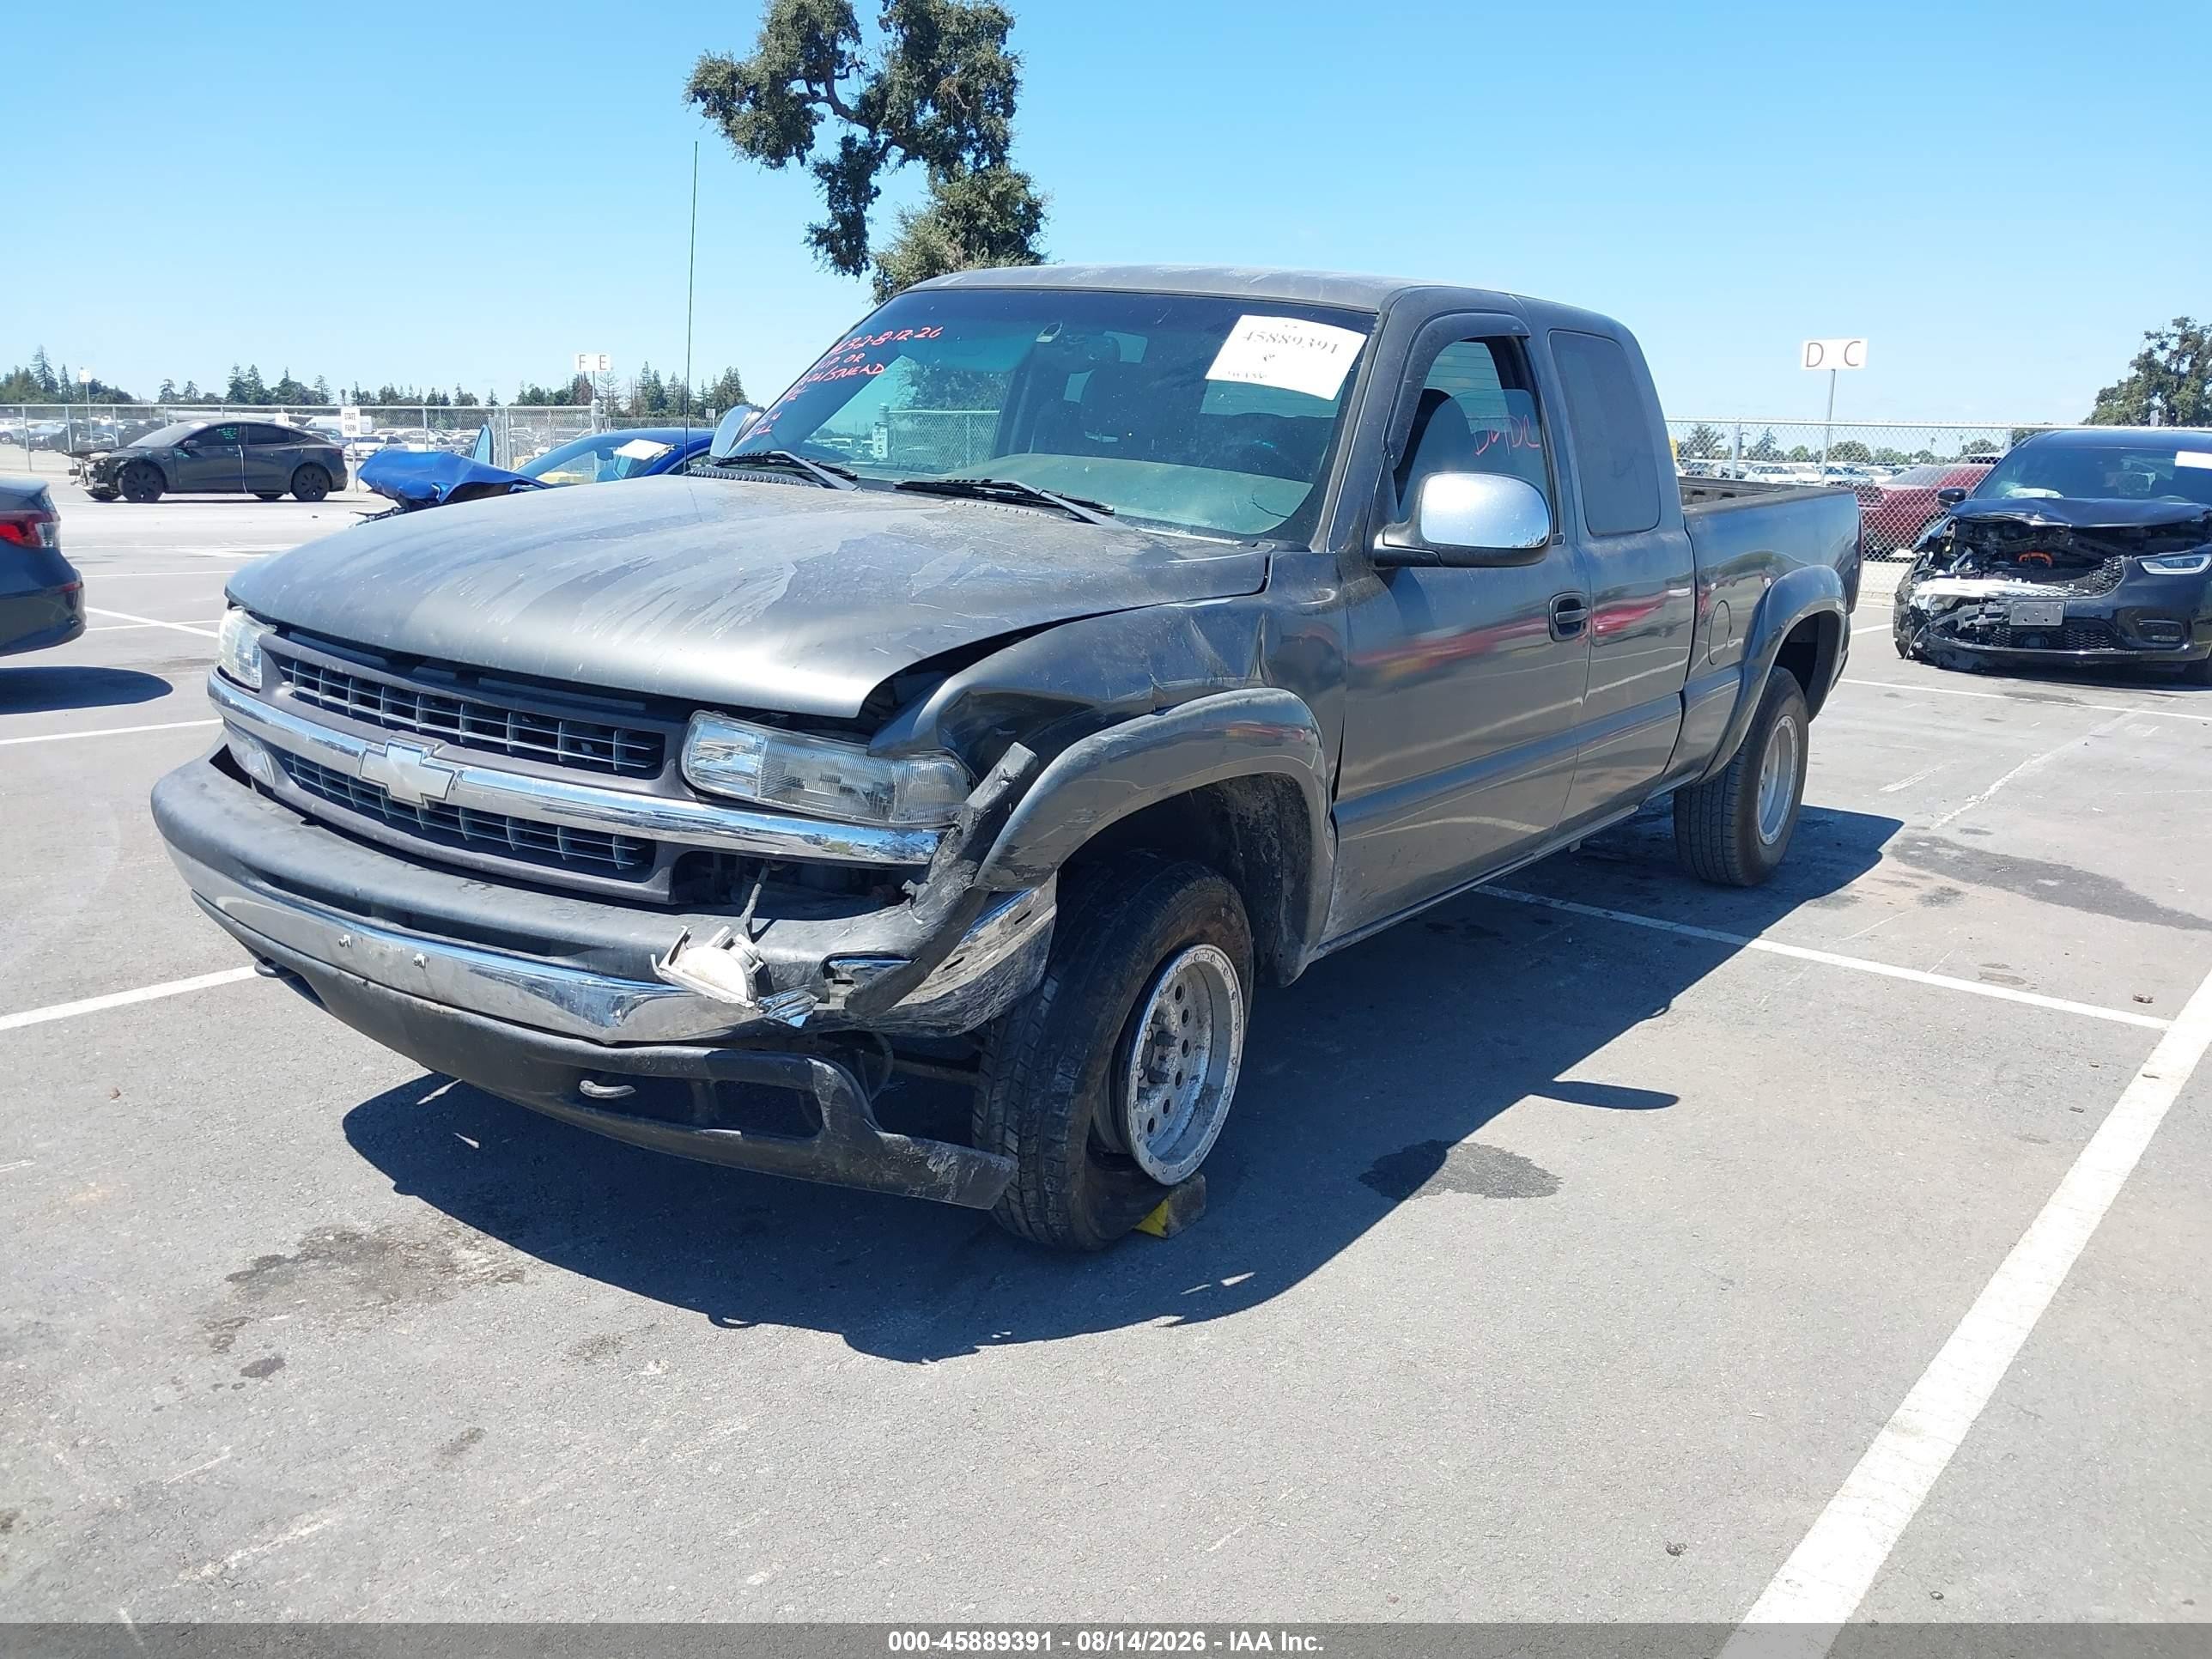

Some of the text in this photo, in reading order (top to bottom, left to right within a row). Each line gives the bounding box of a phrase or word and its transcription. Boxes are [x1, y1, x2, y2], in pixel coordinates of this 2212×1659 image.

[579, 354, 607, 370] F E
[1806, 340, 1862, 368] D C
[878, 444, 884, 454] 5
